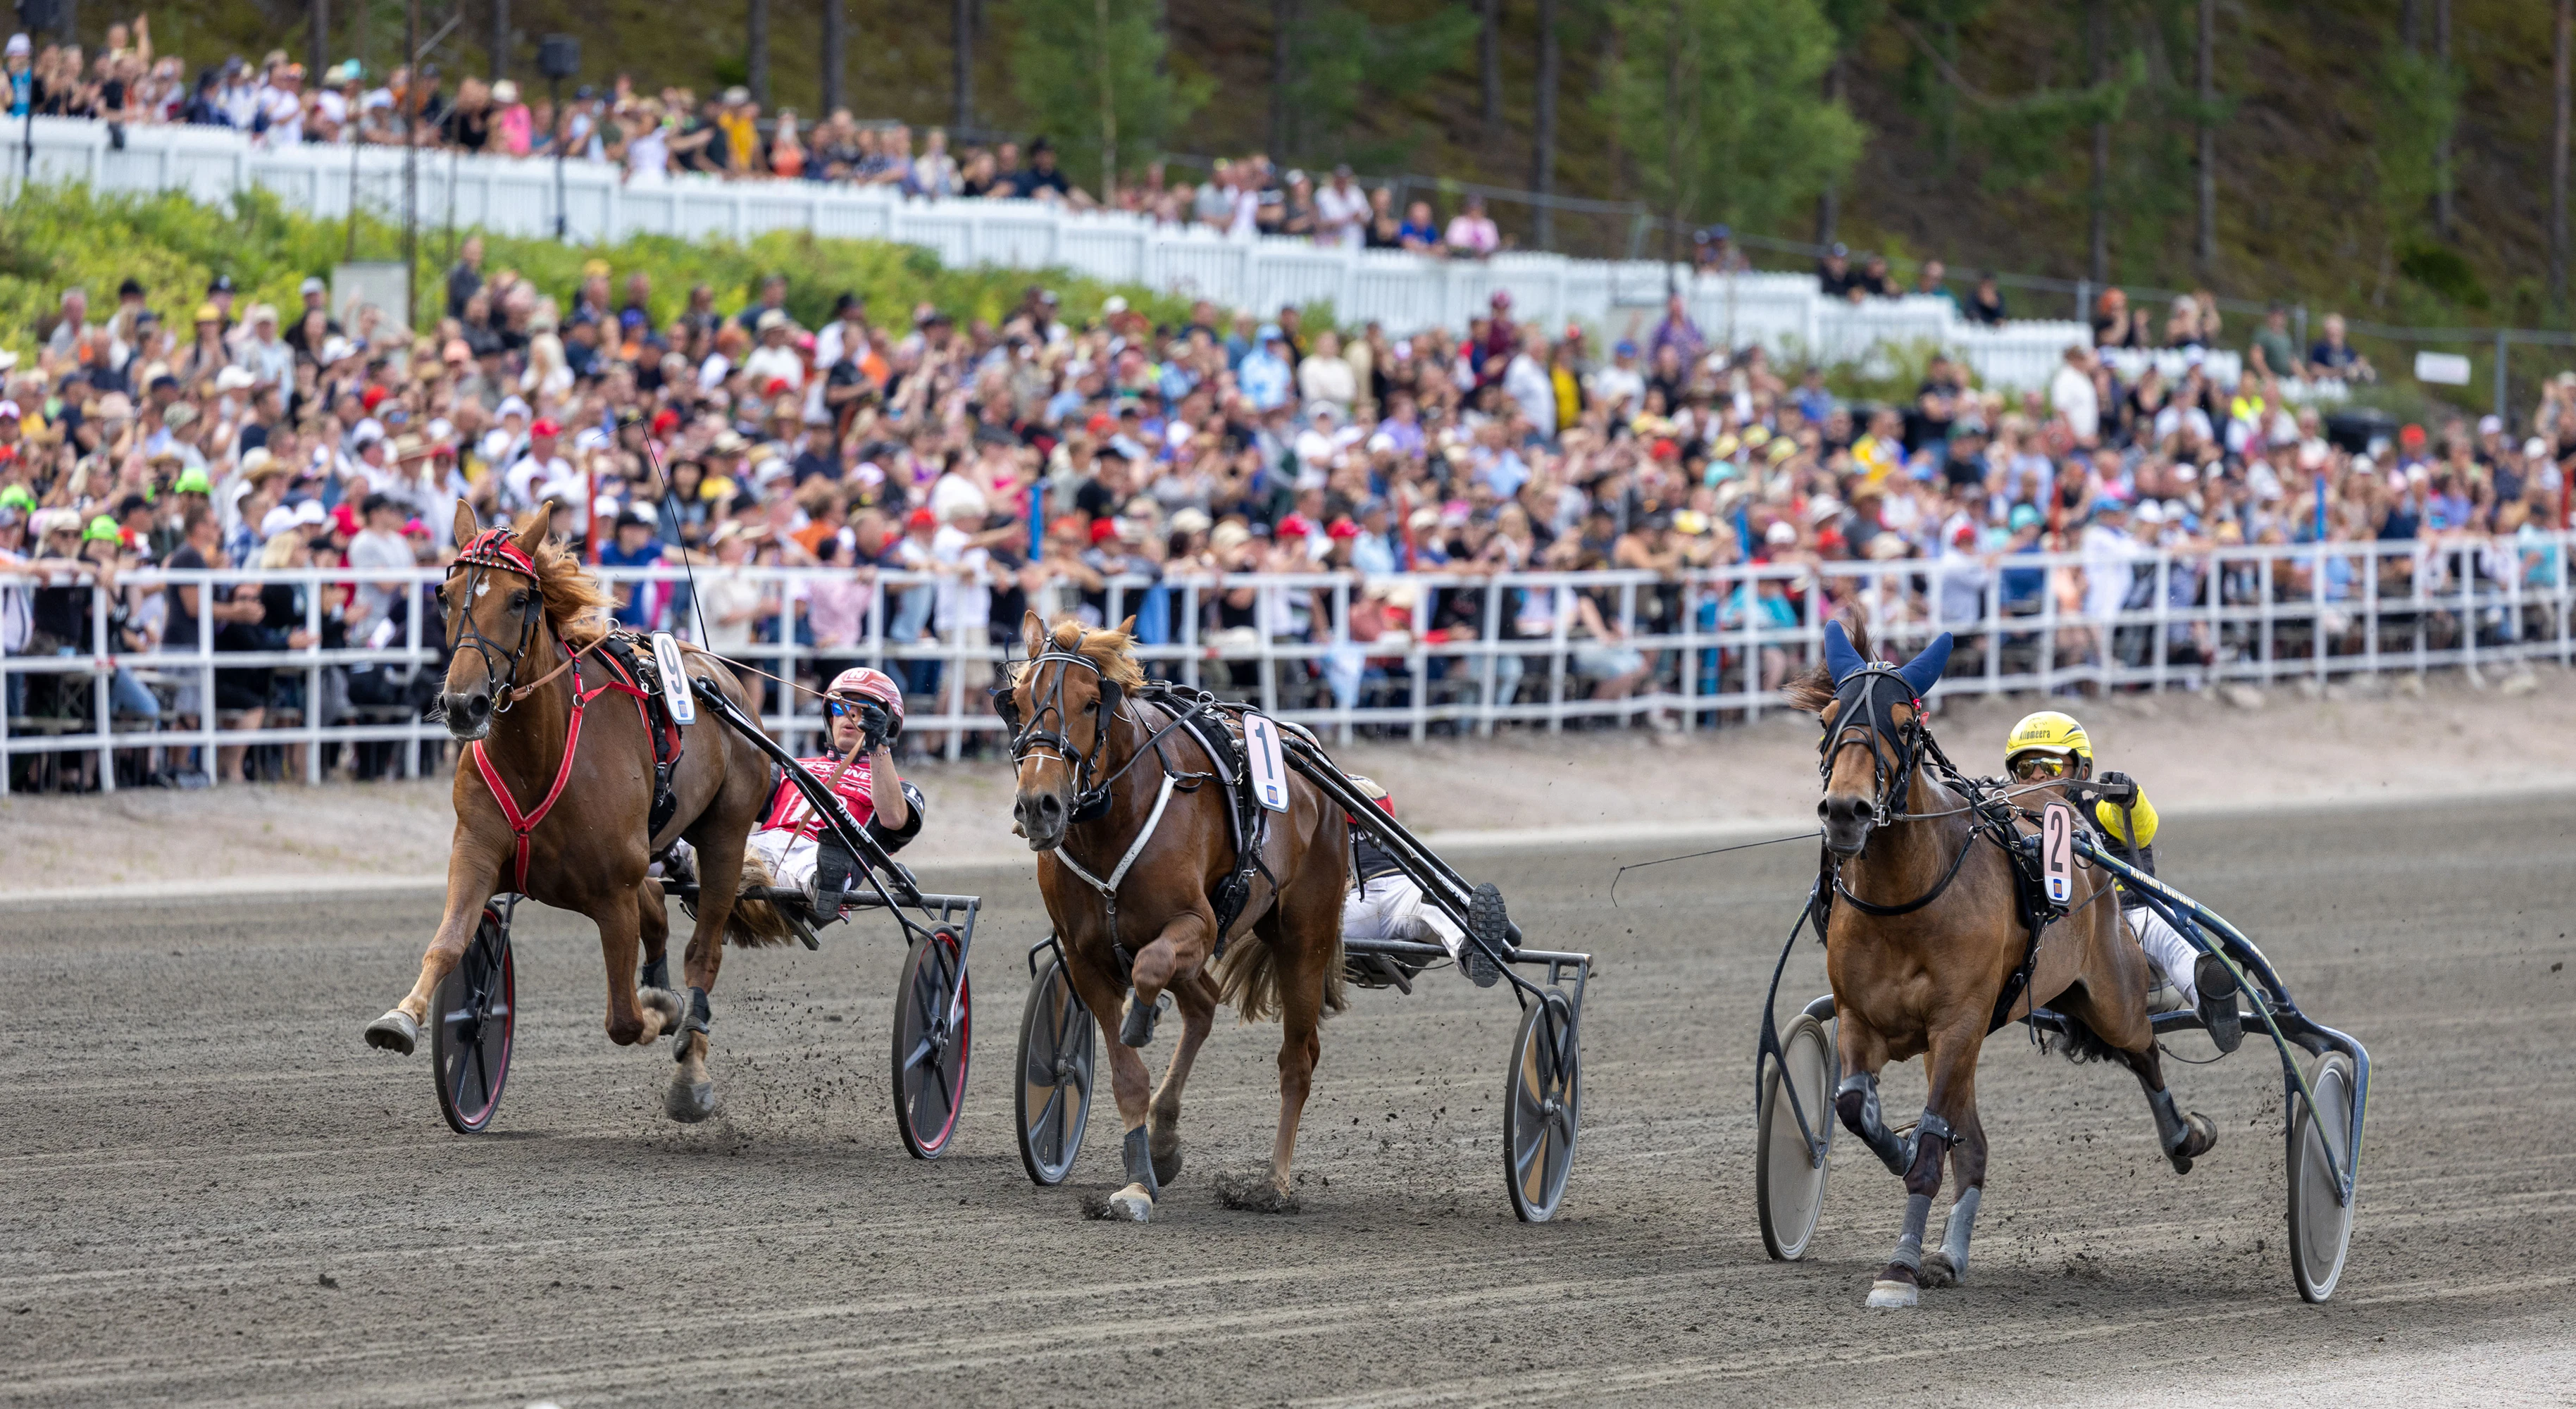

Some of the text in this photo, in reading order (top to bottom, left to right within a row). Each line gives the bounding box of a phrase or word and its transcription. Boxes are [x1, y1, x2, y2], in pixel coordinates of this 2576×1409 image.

[661, 638, 683, 694] 9
[1255, 721, 1274, 780] 1
[2051, 810, 2063, 873] 2
